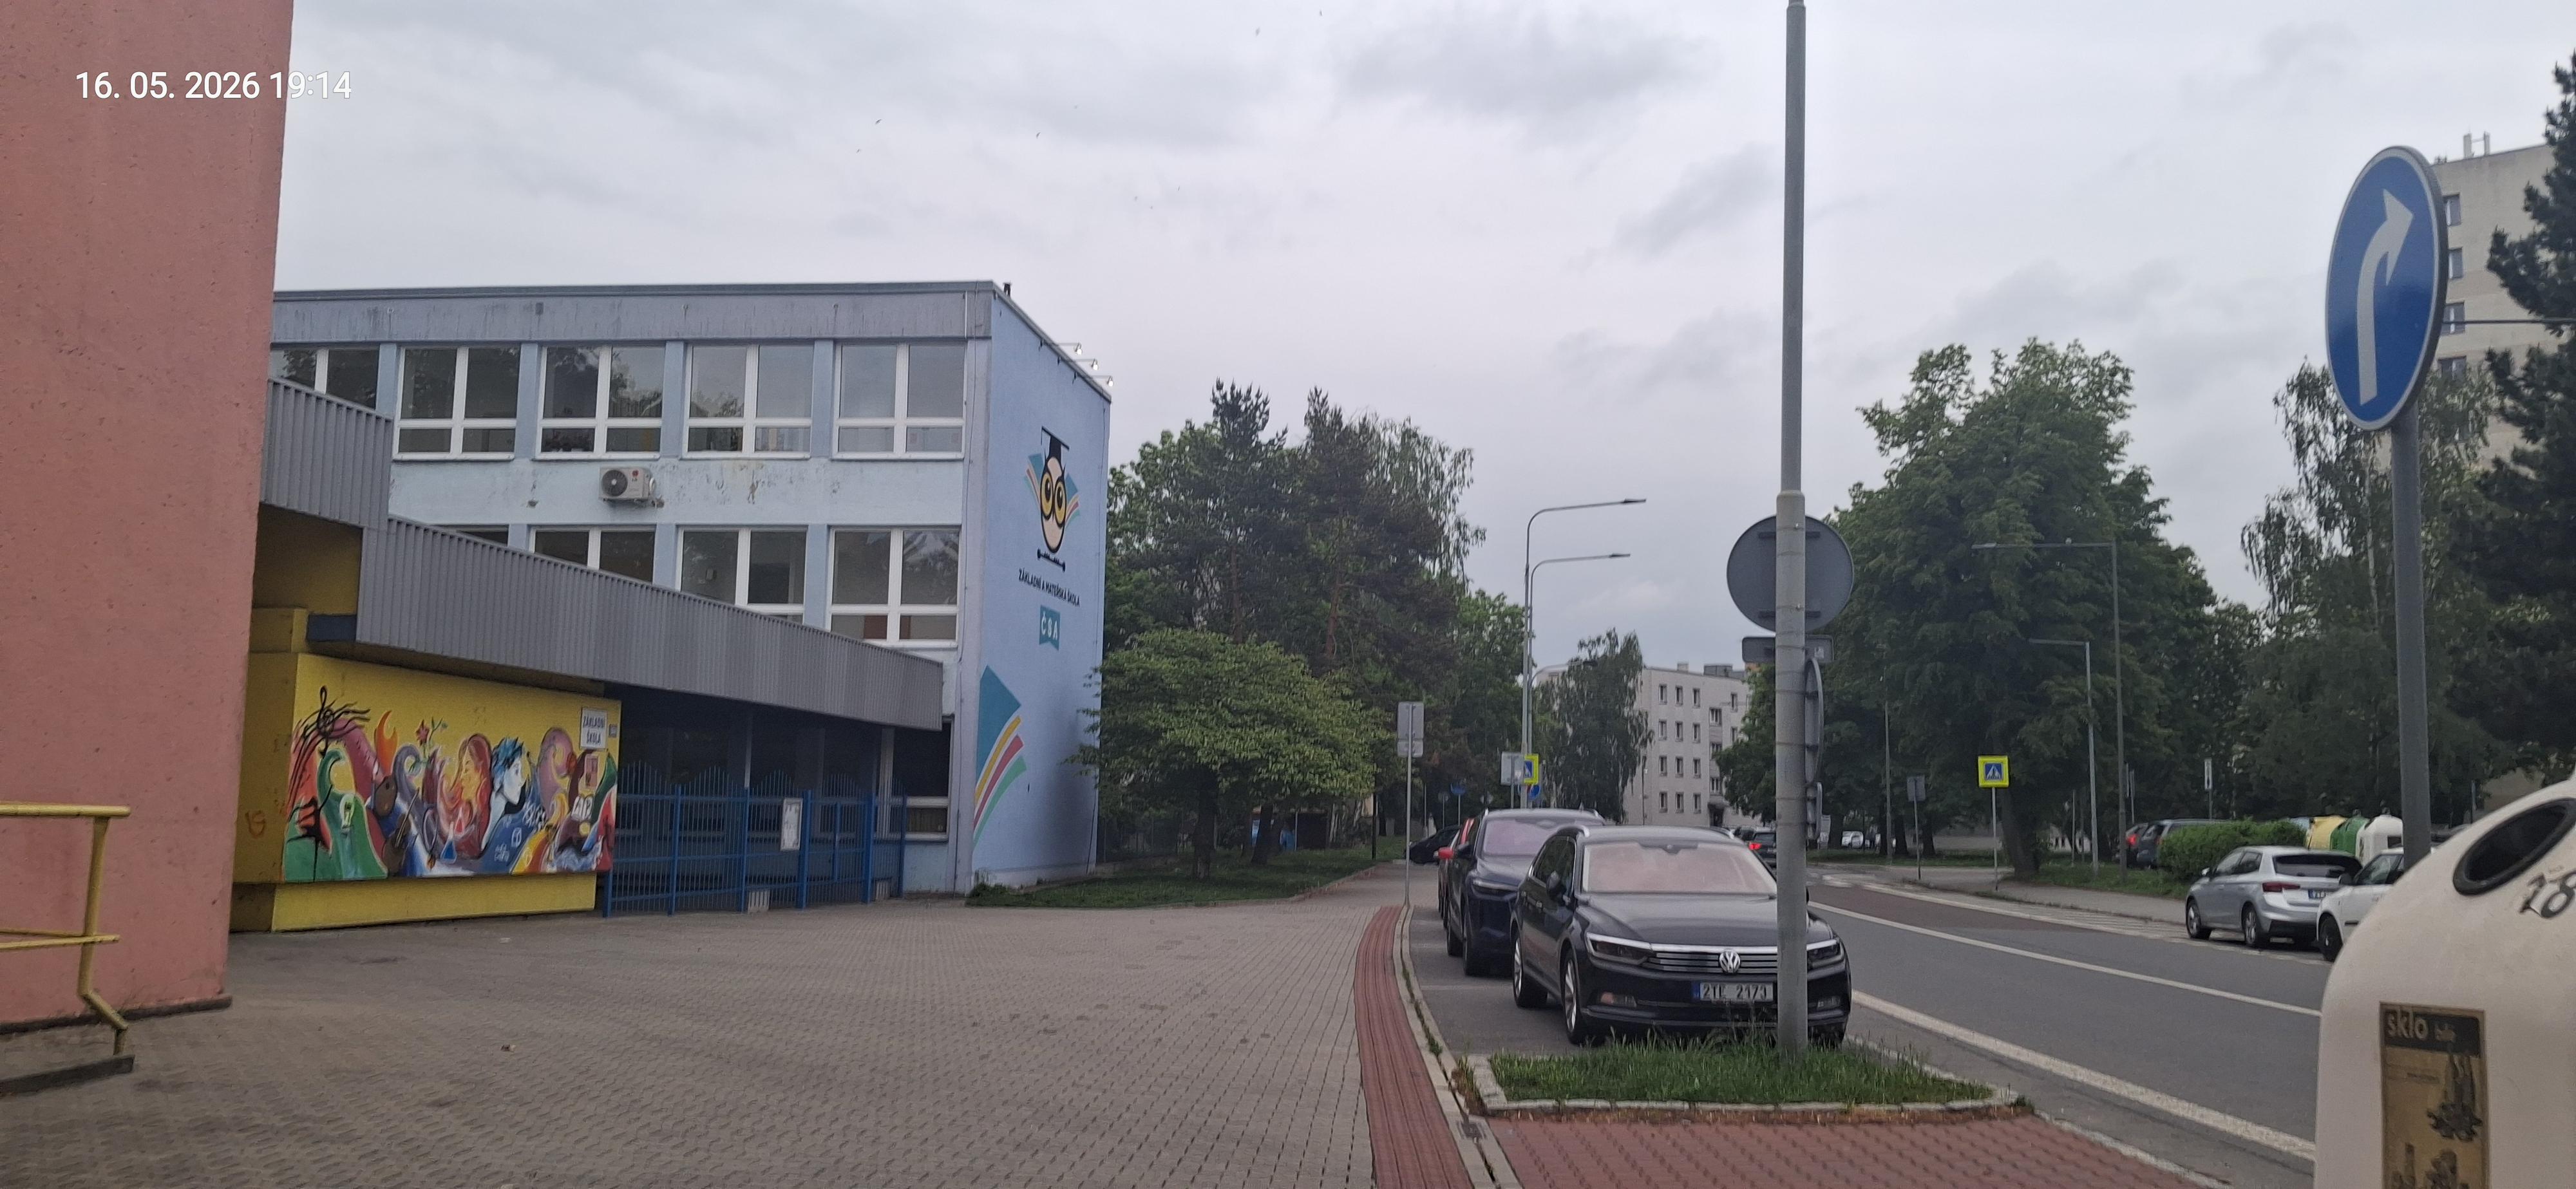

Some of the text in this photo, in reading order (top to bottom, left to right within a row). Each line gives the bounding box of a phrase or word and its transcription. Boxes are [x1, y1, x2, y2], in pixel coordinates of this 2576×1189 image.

[1019, 567, 1041, 590] ZÁKLADNÍ
[1046, 581, 1066, 601] MATEŘSKÁ
[1067, 588, 1080, 607] ŠKOLA
[2387, 1009, 2429, 1040] sklo
